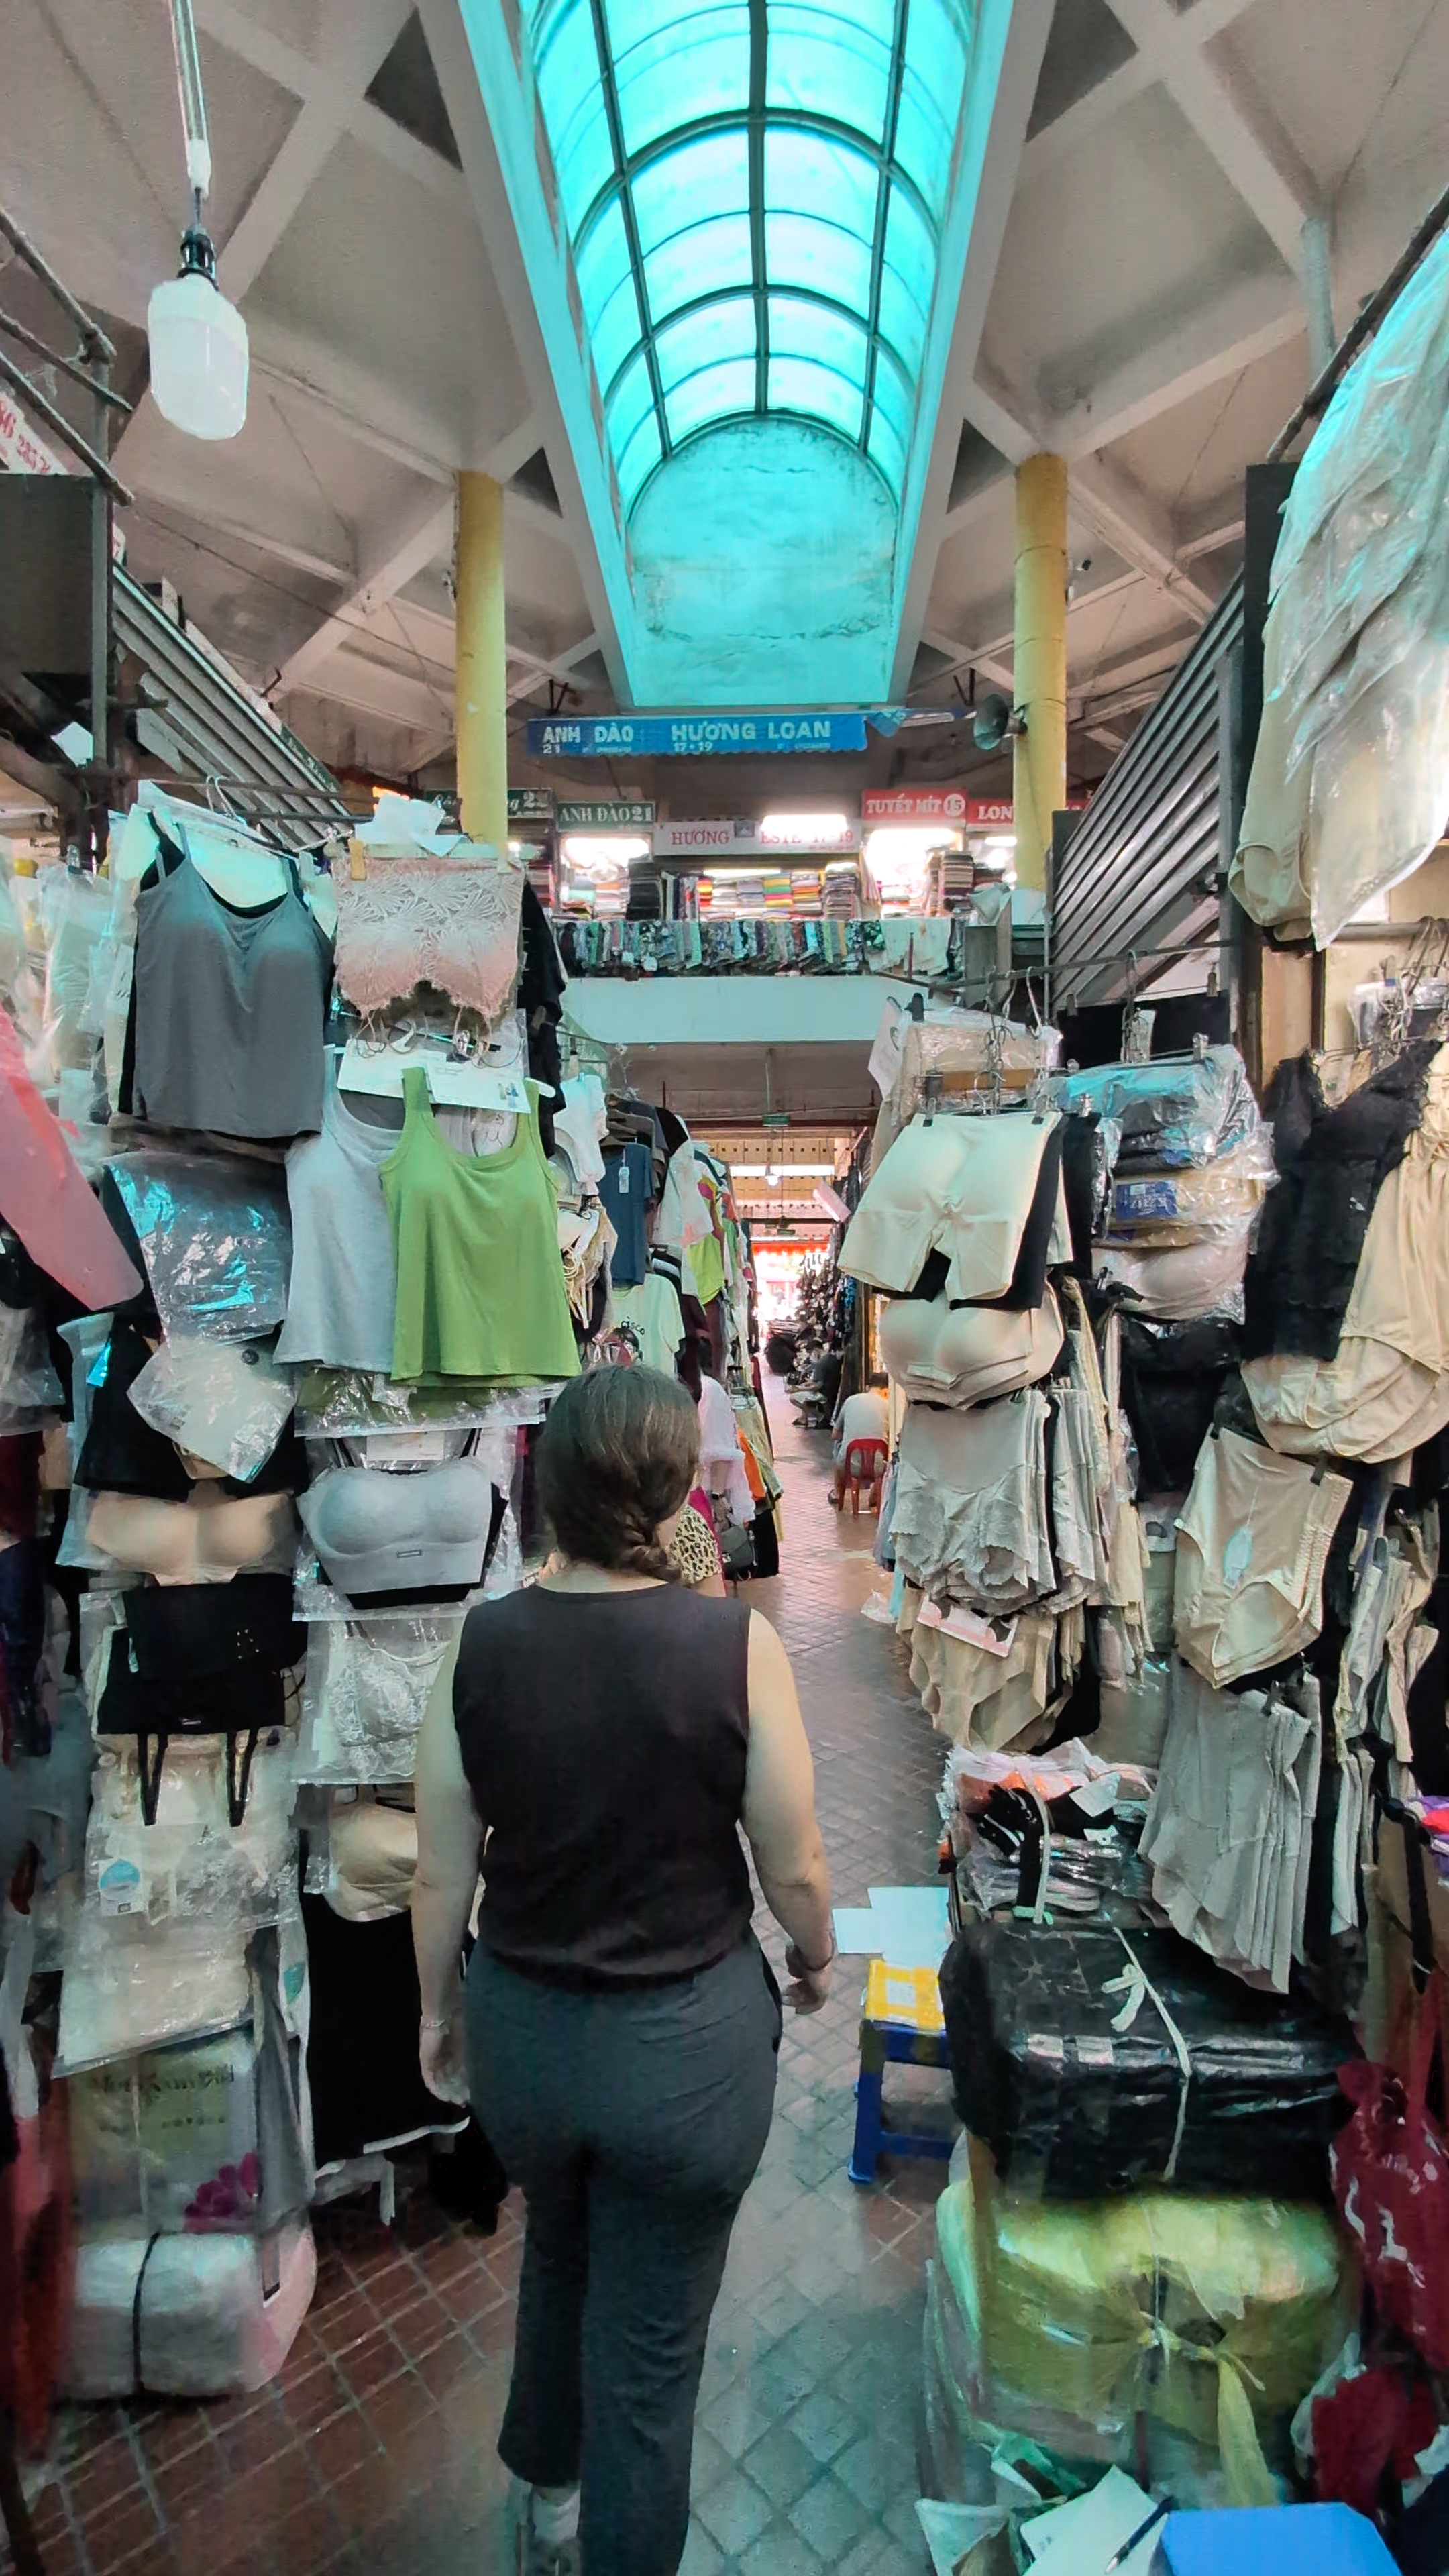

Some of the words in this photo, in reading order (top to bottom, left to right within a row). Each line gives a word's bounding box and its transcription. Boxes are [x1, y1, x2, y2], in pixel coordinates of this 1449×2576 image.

[543, 726, 581, 743] ANH
[594, 722, 634, 743] ĐÀO
[671, 721, 756, 741] HƯƠNG
[767, 720, 832, 739] LOAN
[543, 743, 561, 753] 21
[559, 807, 592, 822] ANH
[672, 829, 730, 845] HƯƠNG
